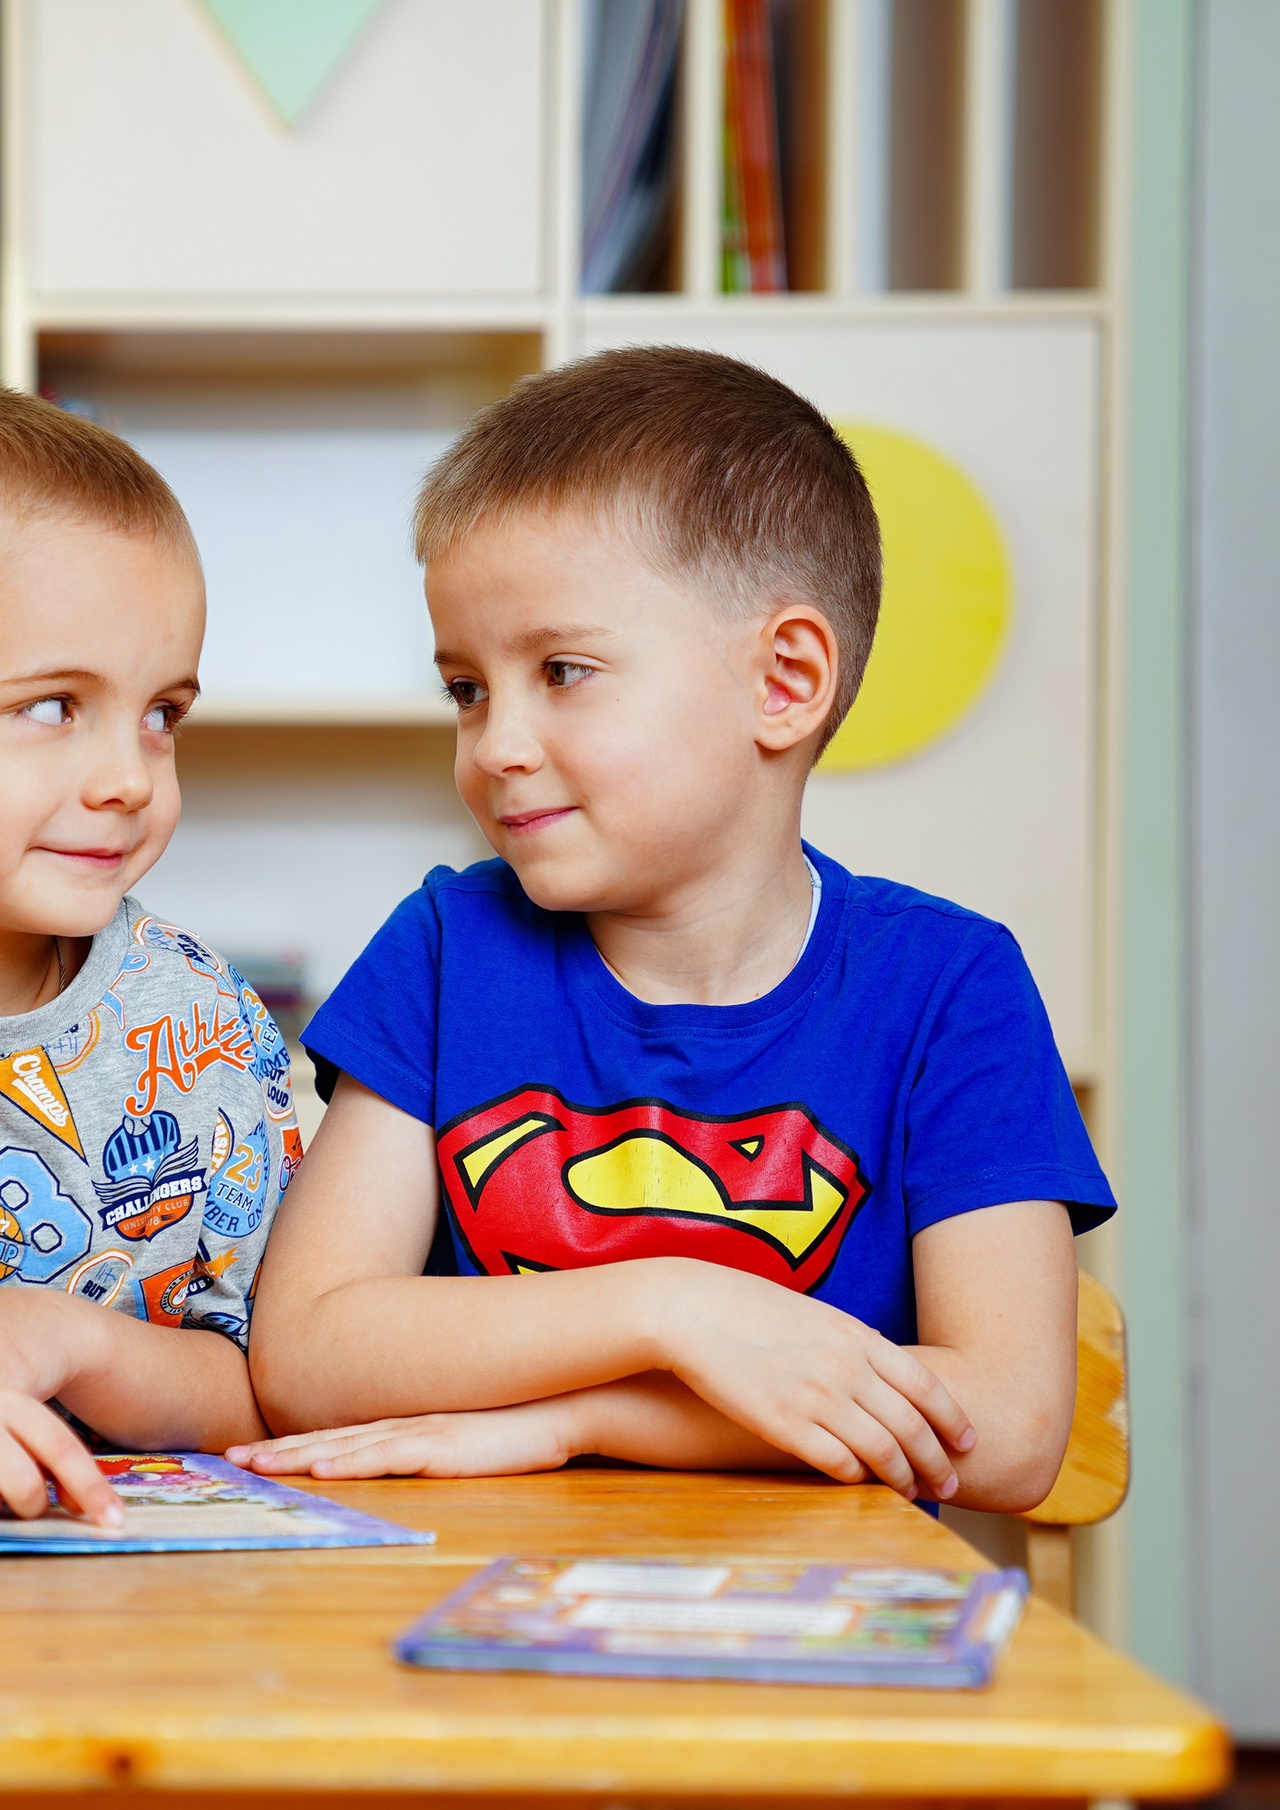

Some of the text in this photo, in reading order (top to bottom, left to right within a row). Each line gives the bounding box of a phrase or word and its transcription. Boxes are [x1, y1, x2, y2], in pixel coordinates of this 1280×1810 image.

[11, 1054, 68, 1127] Champs
[223, 1143, 263, 1193] 23
[164, 1198, 189, 1211] CLUB
[215, 1181, 254, 1213] TEAM
